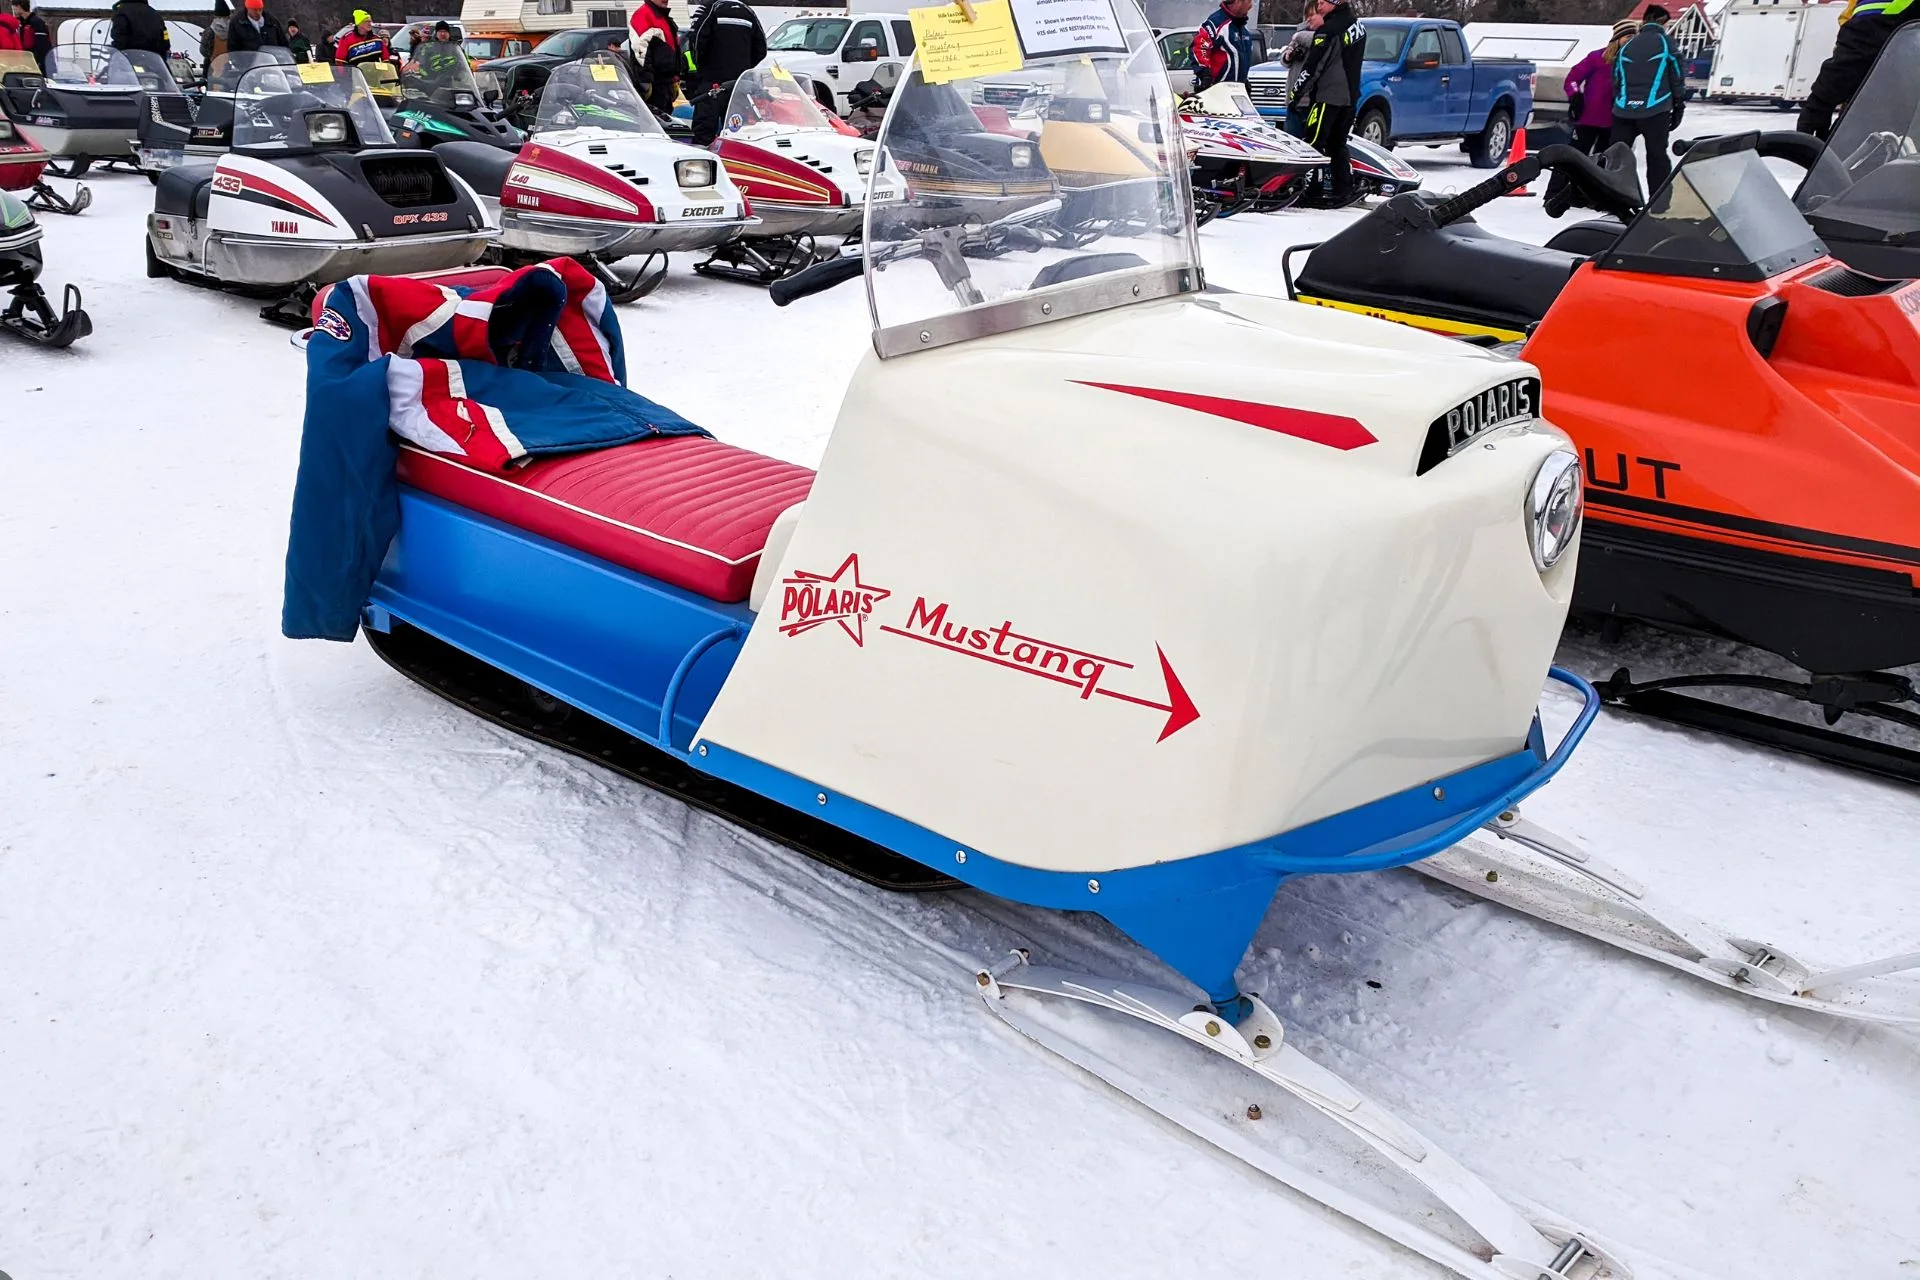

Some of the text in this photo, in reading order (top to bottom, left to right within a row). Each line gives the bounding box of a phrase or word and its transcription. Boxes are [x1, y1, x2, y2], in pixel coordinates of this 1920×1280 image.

[1293, 69, 1311, 92] FXR
[912, 162, 938, 175] YAMAHA
[213, 175, 241, 192] 433
[511, 174, 530, 184] 440
[738, 184, 750, 195] 40
[862, 190, 894, 201] CITER
[517, 193, 539, 207] YAMAHA
[420, 212, 448, 222] 433
[682, 206, 725, 218] EXCITER
[271, 220, 299, 234] YAMAHA
[1446, 379, 1531, 449] POLARIS
[1584, 447, 1681, 500] UT
[781, 584, 874, 622] POLARIS
[905, 596, 1106, 700] Mustang
